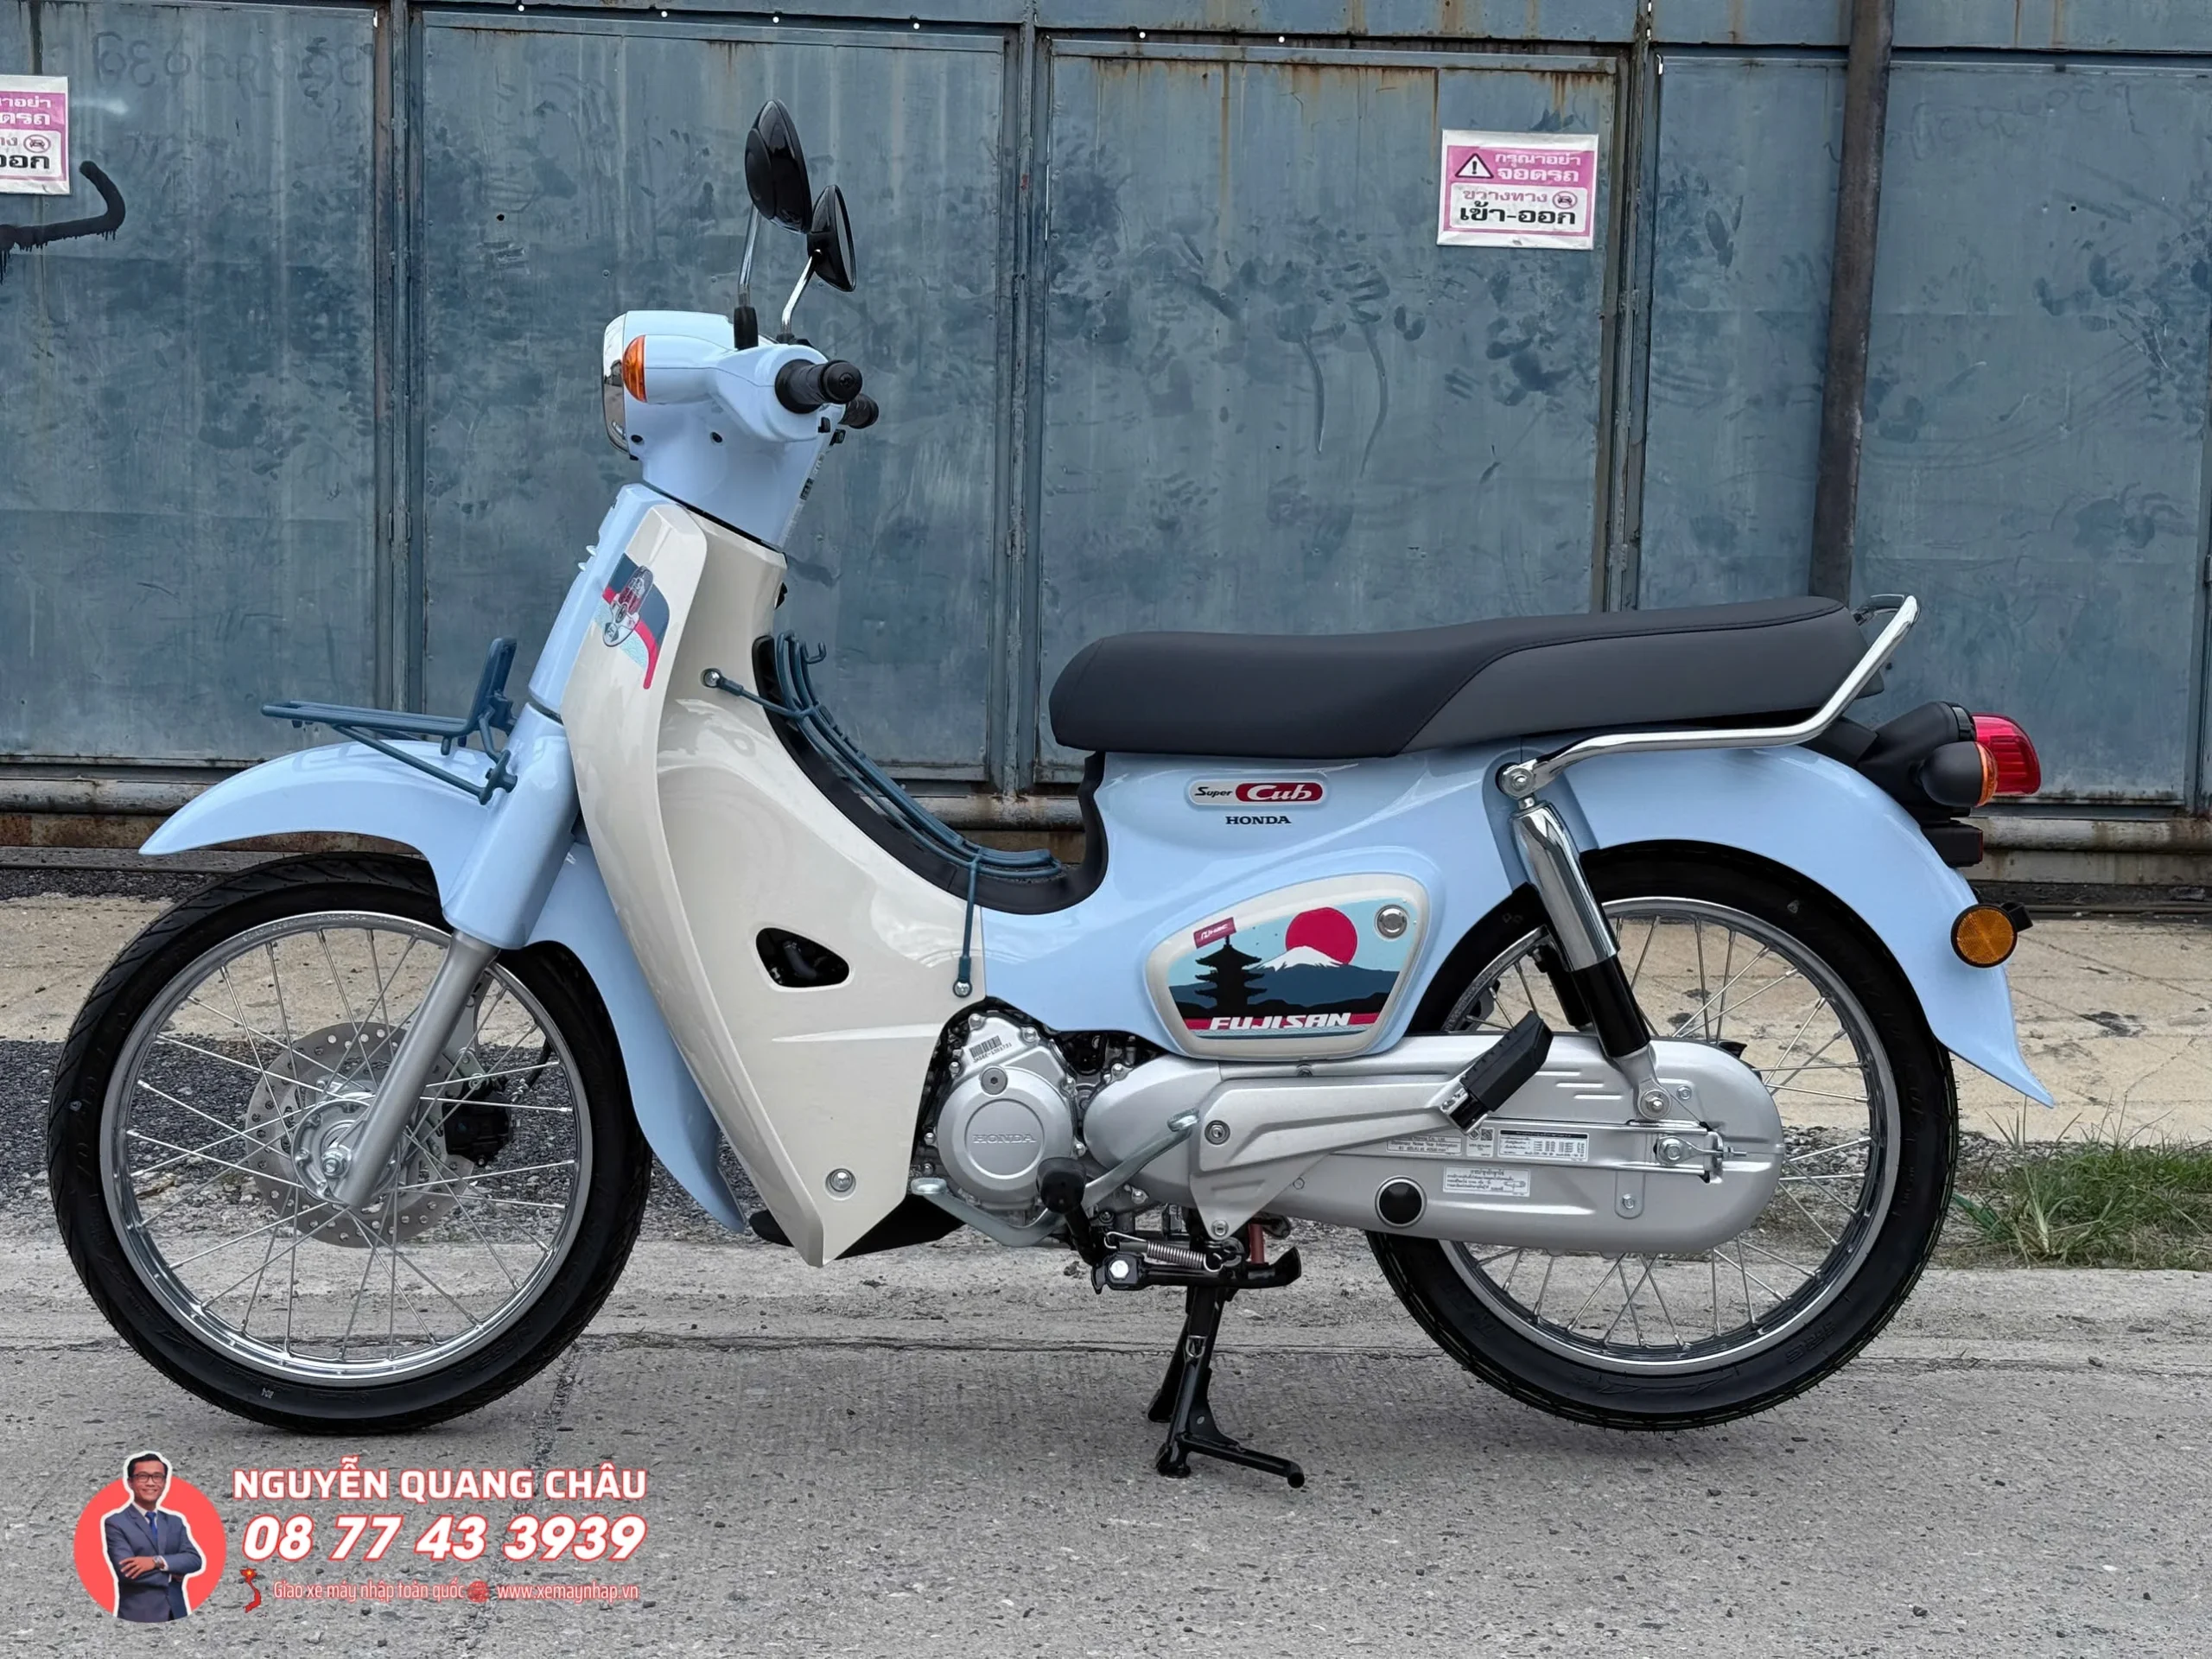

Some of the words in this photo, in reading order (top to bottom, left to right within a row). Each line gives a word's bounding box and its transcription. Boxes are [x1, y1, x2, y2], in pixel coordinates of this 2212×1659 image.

[1495, 152, 1581, 168] กรุณาอย่า
[1497, 168, 1580, 182] จอดรถ
[1463, 189, 1548, 203] ขวางทาง
[1459, 200, 1576, 225] เข้า-ออก
[1193, 785, 1233, 798] Super
[1246, 784, 1313, 800] Cub
[1224, 816, 1292, 824] HONDA
[1210, 1012, 1351, 1031] FUJISAN
[972, 1133, 1037, 1144] HONDA
